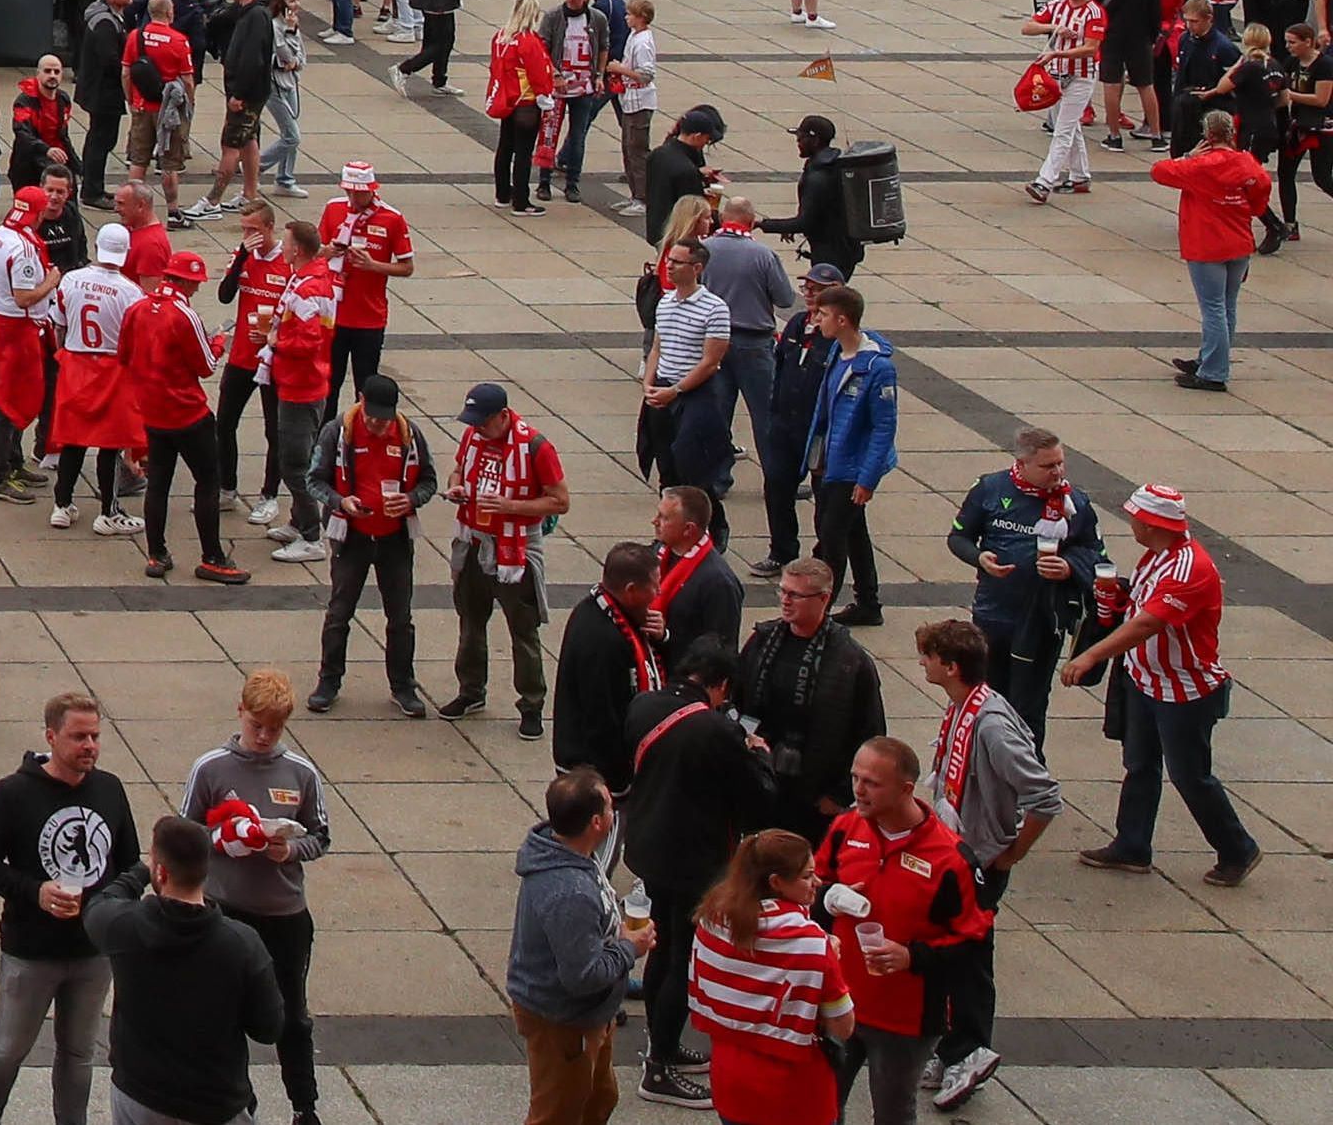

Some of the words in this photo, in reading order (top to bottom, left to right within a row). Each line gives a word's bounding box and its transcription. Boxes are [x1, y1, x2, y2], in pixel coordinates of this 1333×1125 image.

[80, 281, 90, 291] FC
[91, 282, 118, 297] UNION
[79, 303, 103, 349] 6
[948, 712, 975, 781] Berlin
